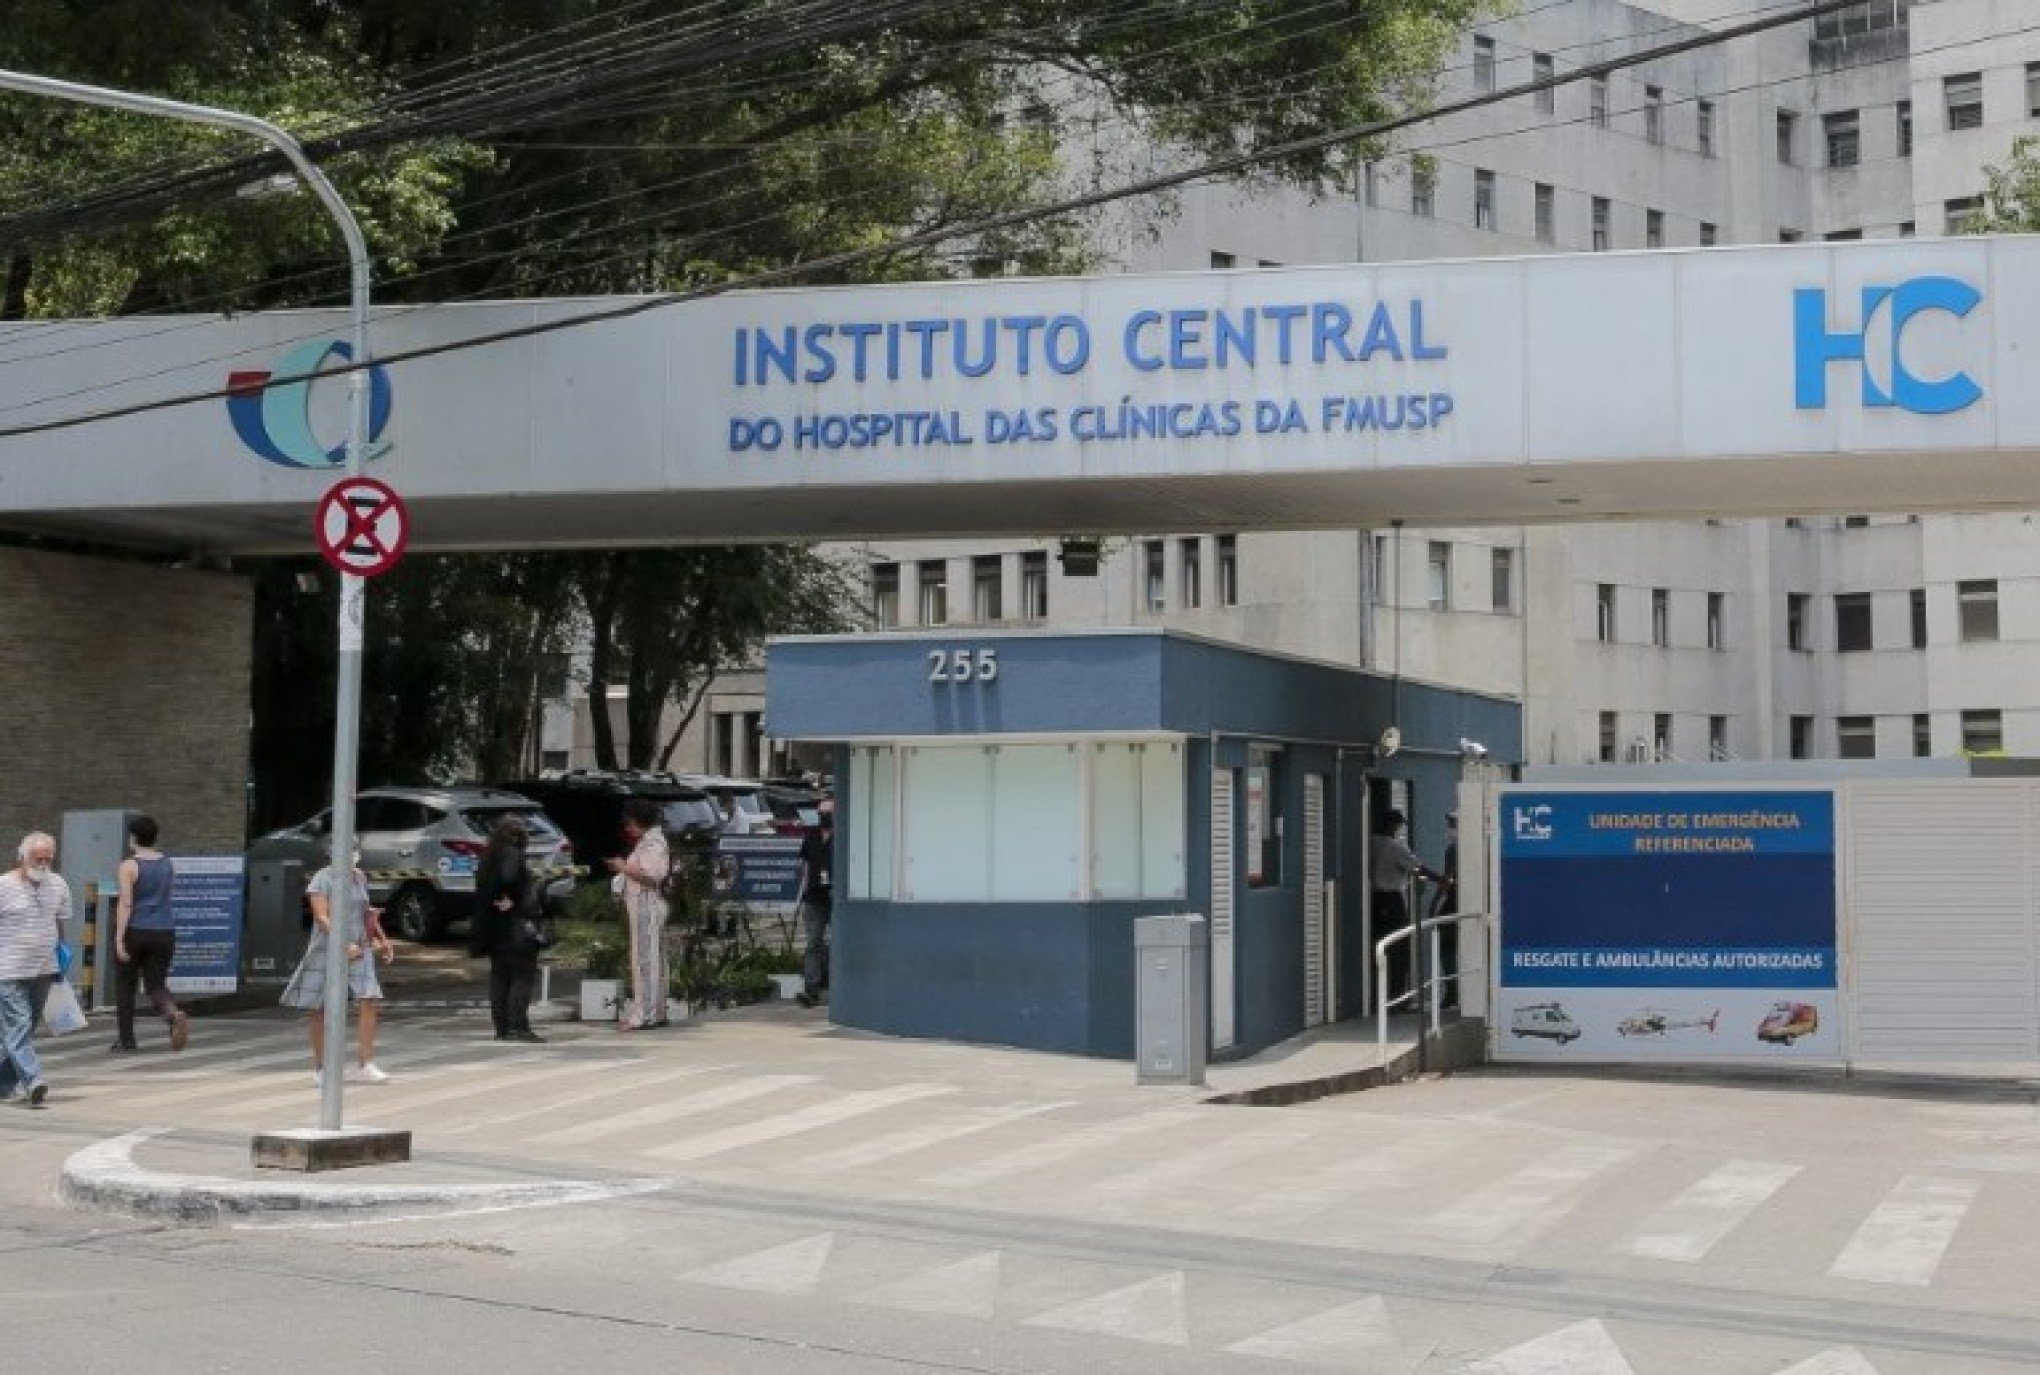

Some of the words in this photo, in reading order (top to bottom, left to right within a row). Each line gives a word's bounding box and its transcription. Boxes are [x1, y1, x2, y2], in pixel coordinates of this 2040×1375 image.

[735, 314, 1090, 386] INSTITUTO
[1123, 300, 1448, 372] CENTRAL
[1795, 275, 1983, 414] HC
[729, 417, 784, 451] DO
[794, 411, 972, 450] HOSPITAL
[985, 408, 1057, 444] DAS
[1070, 396, 1241, 442] CLÍNICAS
[1255, 399, 1308, 434] DA
[1323, 393, 1453, 432] FMUSP
[928, 649, 997, 681] 255
[1590, 814, 1664, 829] UNIDADE
[1667, 814, 1688, 829] DE
[1694, 810, 1799, 829] EMERGÊNCIA
[1635, 837, 1754, 852] REFERENCIADA
[1513, 952, 1579, 967] RESGATE
[1582, 952, 1592, 967] E
[1596, 949, 1709, 968] AMBULÂNCIAS
[1713, 953, 1823, 969] AUTORIZADAS
